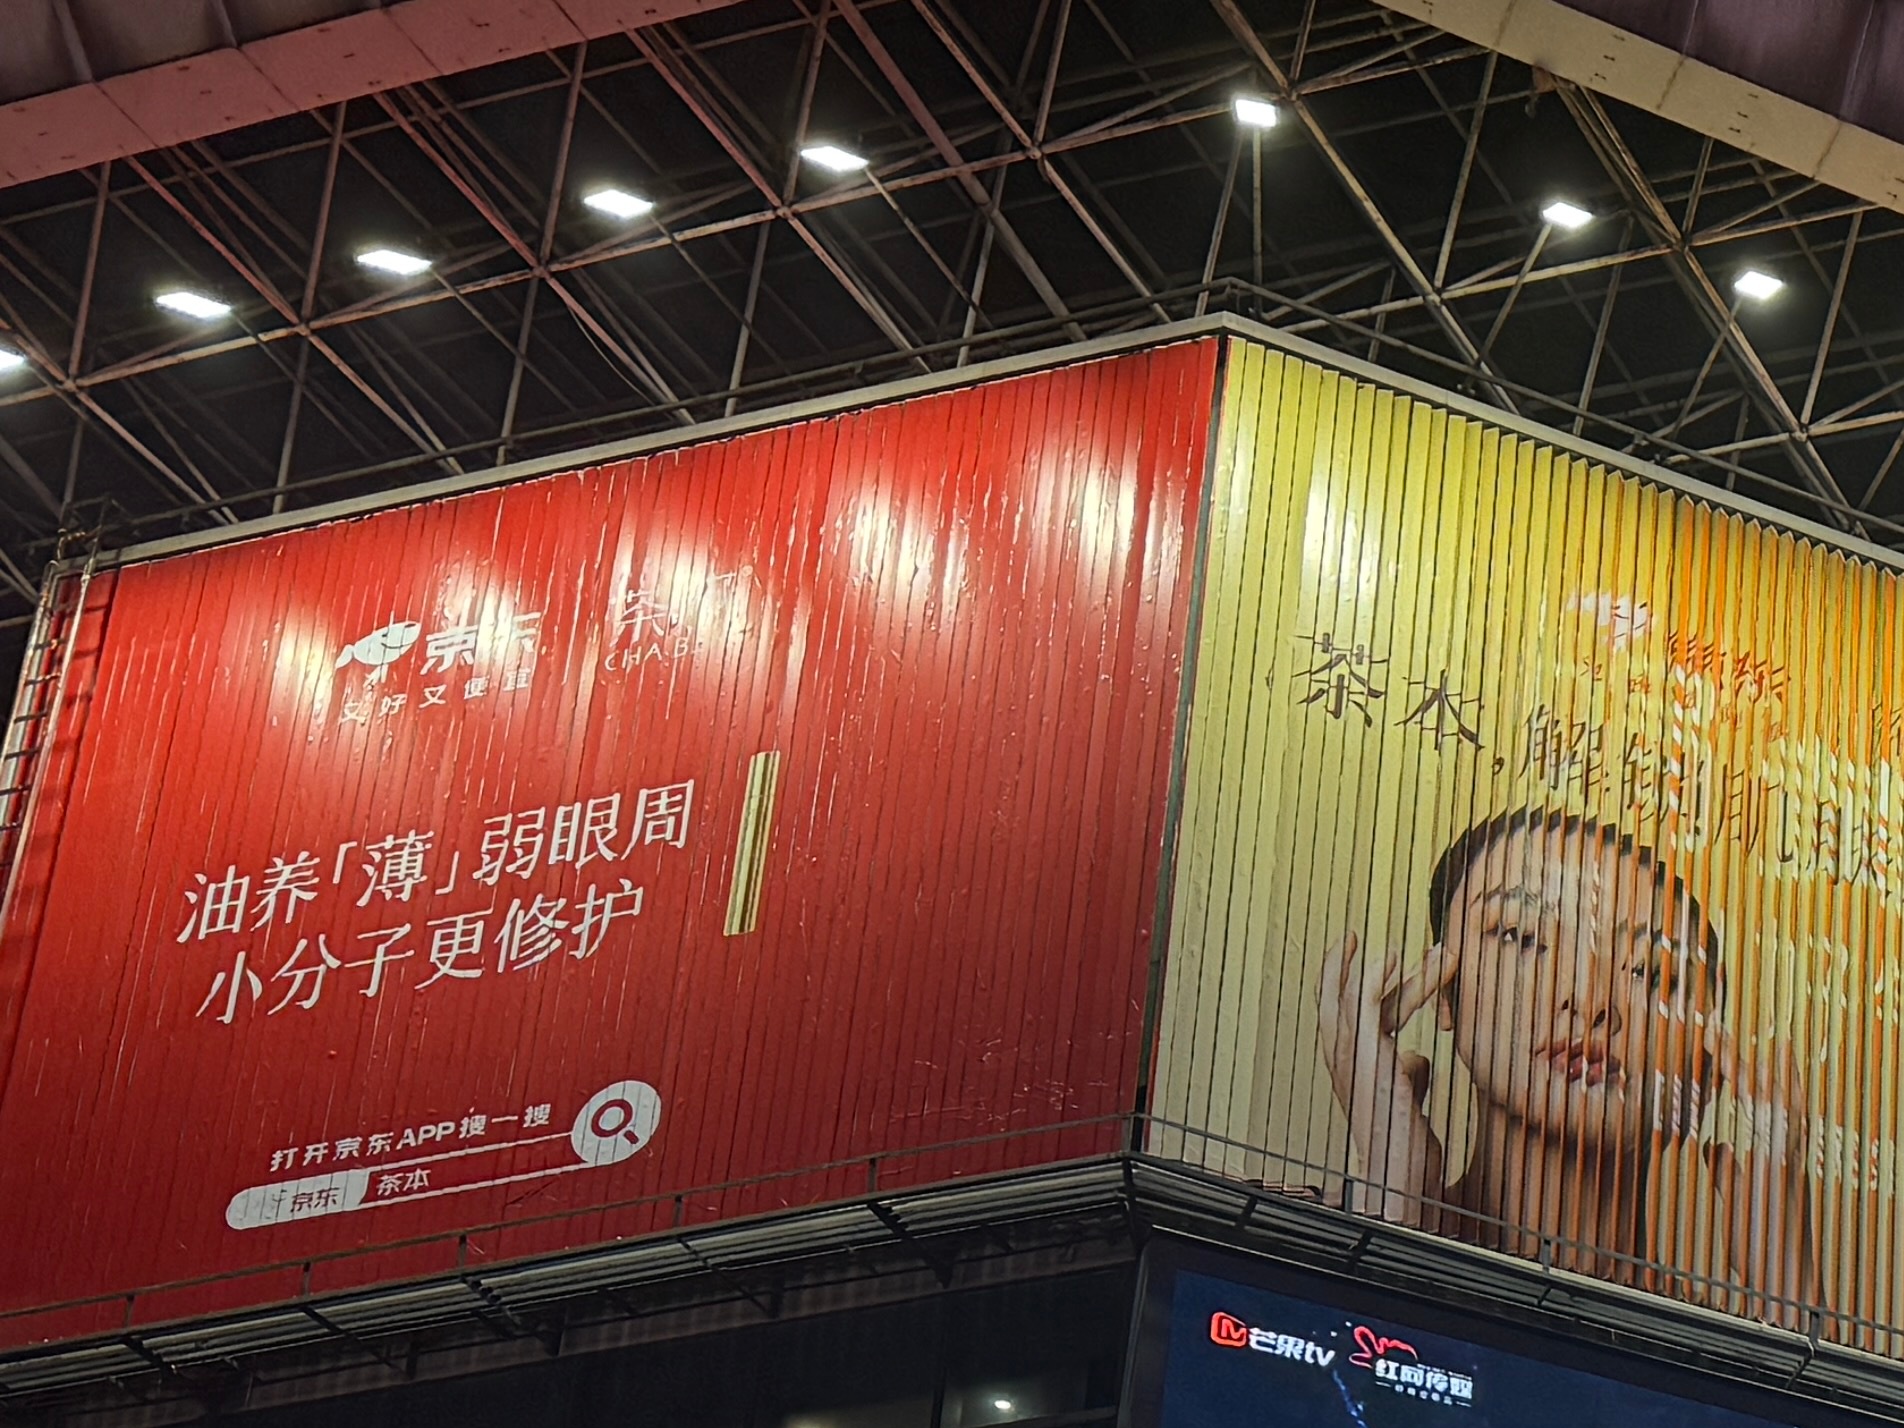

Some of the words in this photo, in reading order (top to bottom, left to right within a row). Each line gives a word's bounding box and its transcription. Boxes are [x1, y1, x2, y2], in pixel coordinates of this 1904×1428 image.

[176, 778, 695, 944] 油养「薄」弱眼周
[195, 878, 644, 1026] 小分子更修护
[269, 1103, 552, 1173] 打开京东APP搜一搜
[375, 1168, 431, 1197] 茶本
